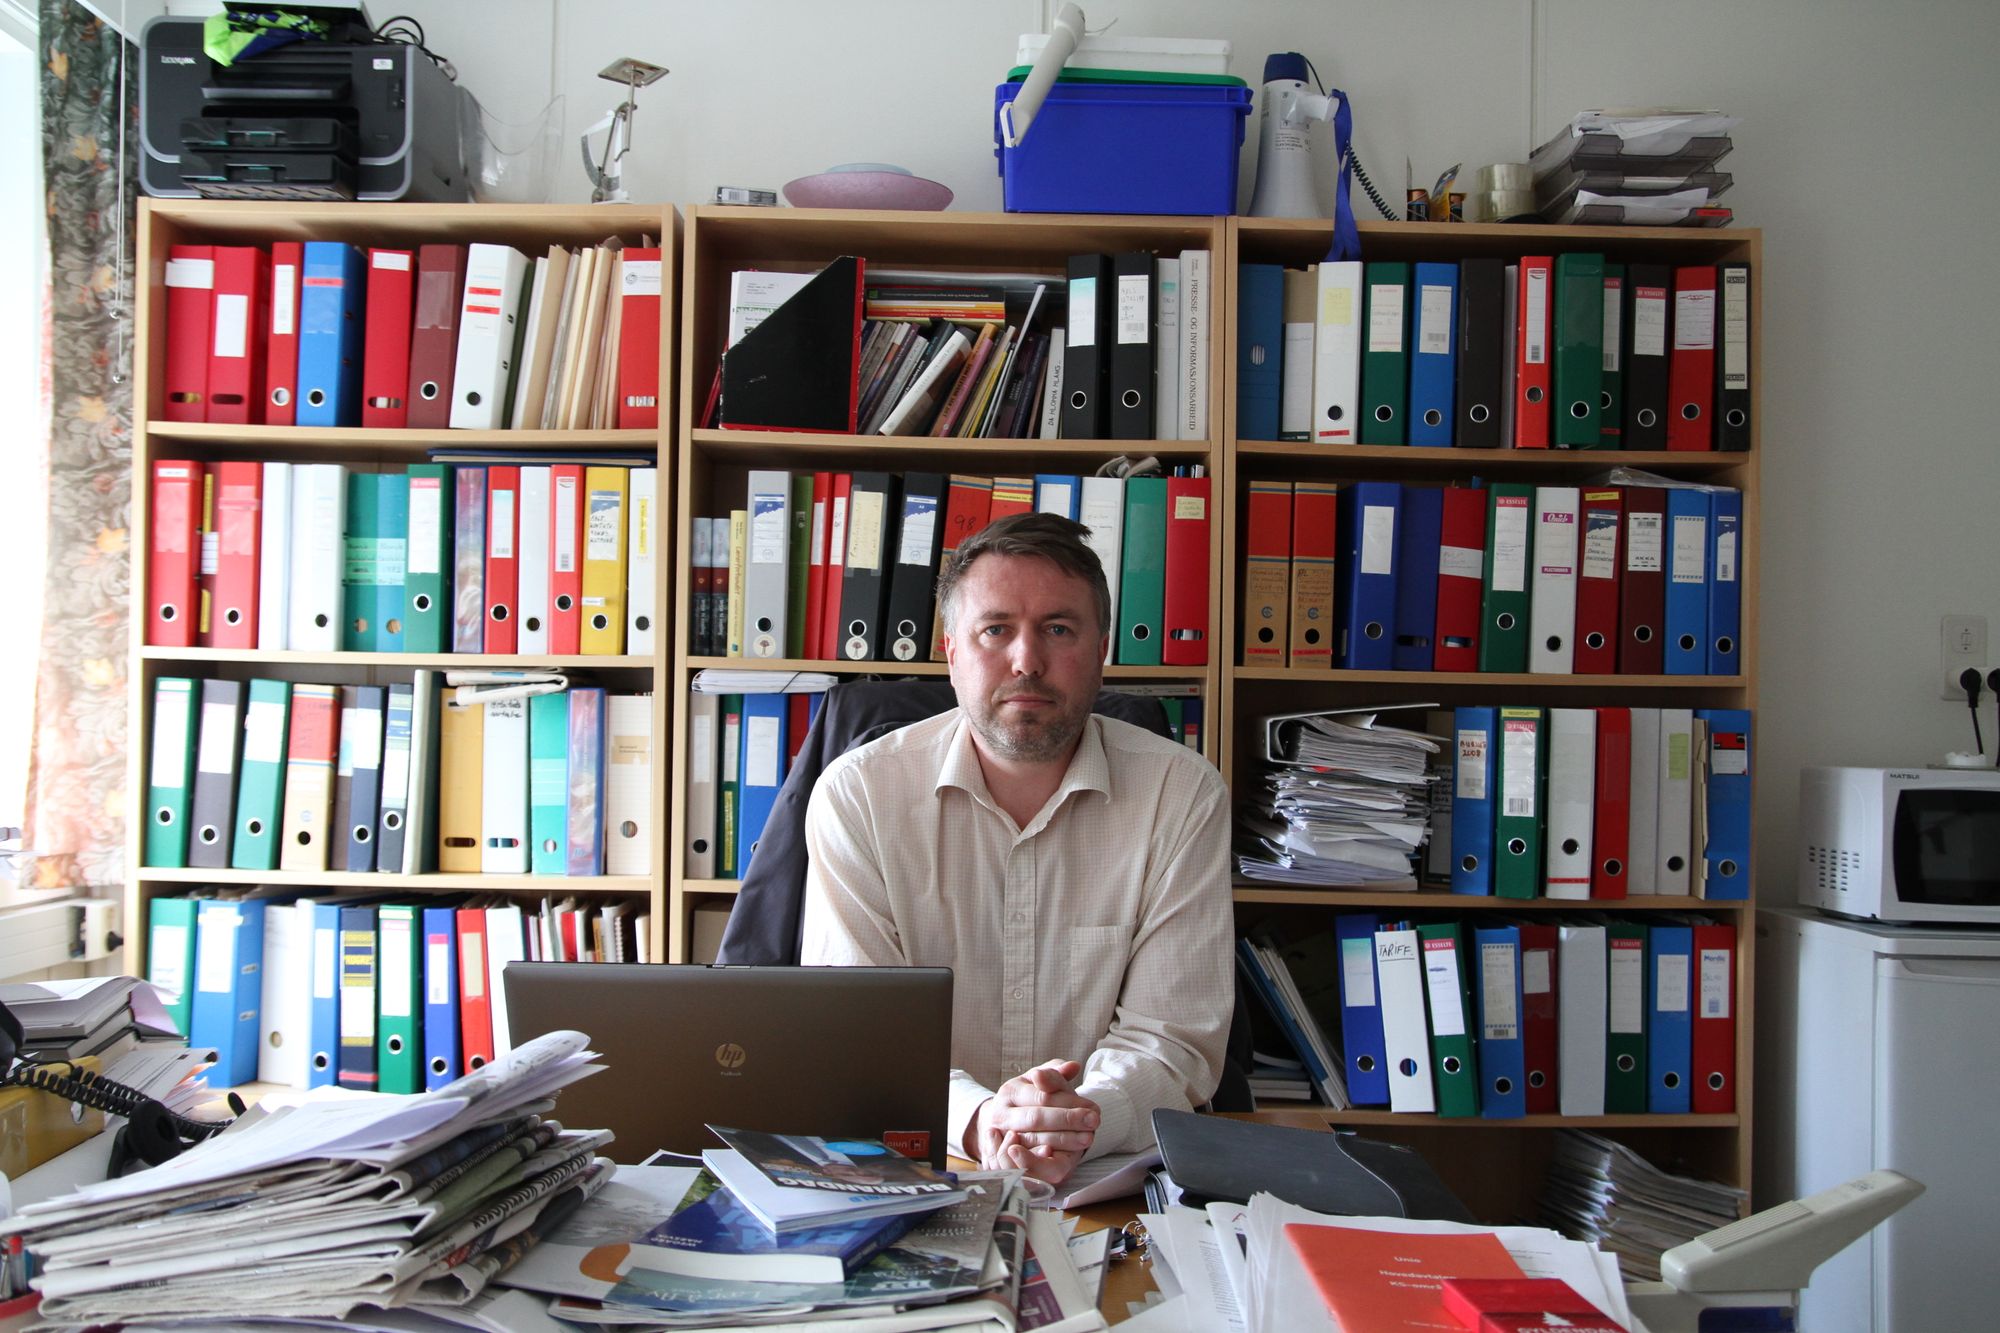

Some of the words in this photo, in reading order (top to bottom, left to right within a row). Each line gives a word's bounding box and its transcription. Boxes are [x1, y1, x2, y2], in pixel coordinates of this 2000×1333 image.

[1190, 317, 1198, 330] OG
[1188, 331, 1198, 431] INFORMASJONSARBEID
[954, 514, 977, 531] 98
[777, 1177, 952, 1195] BLÅMANDAG
